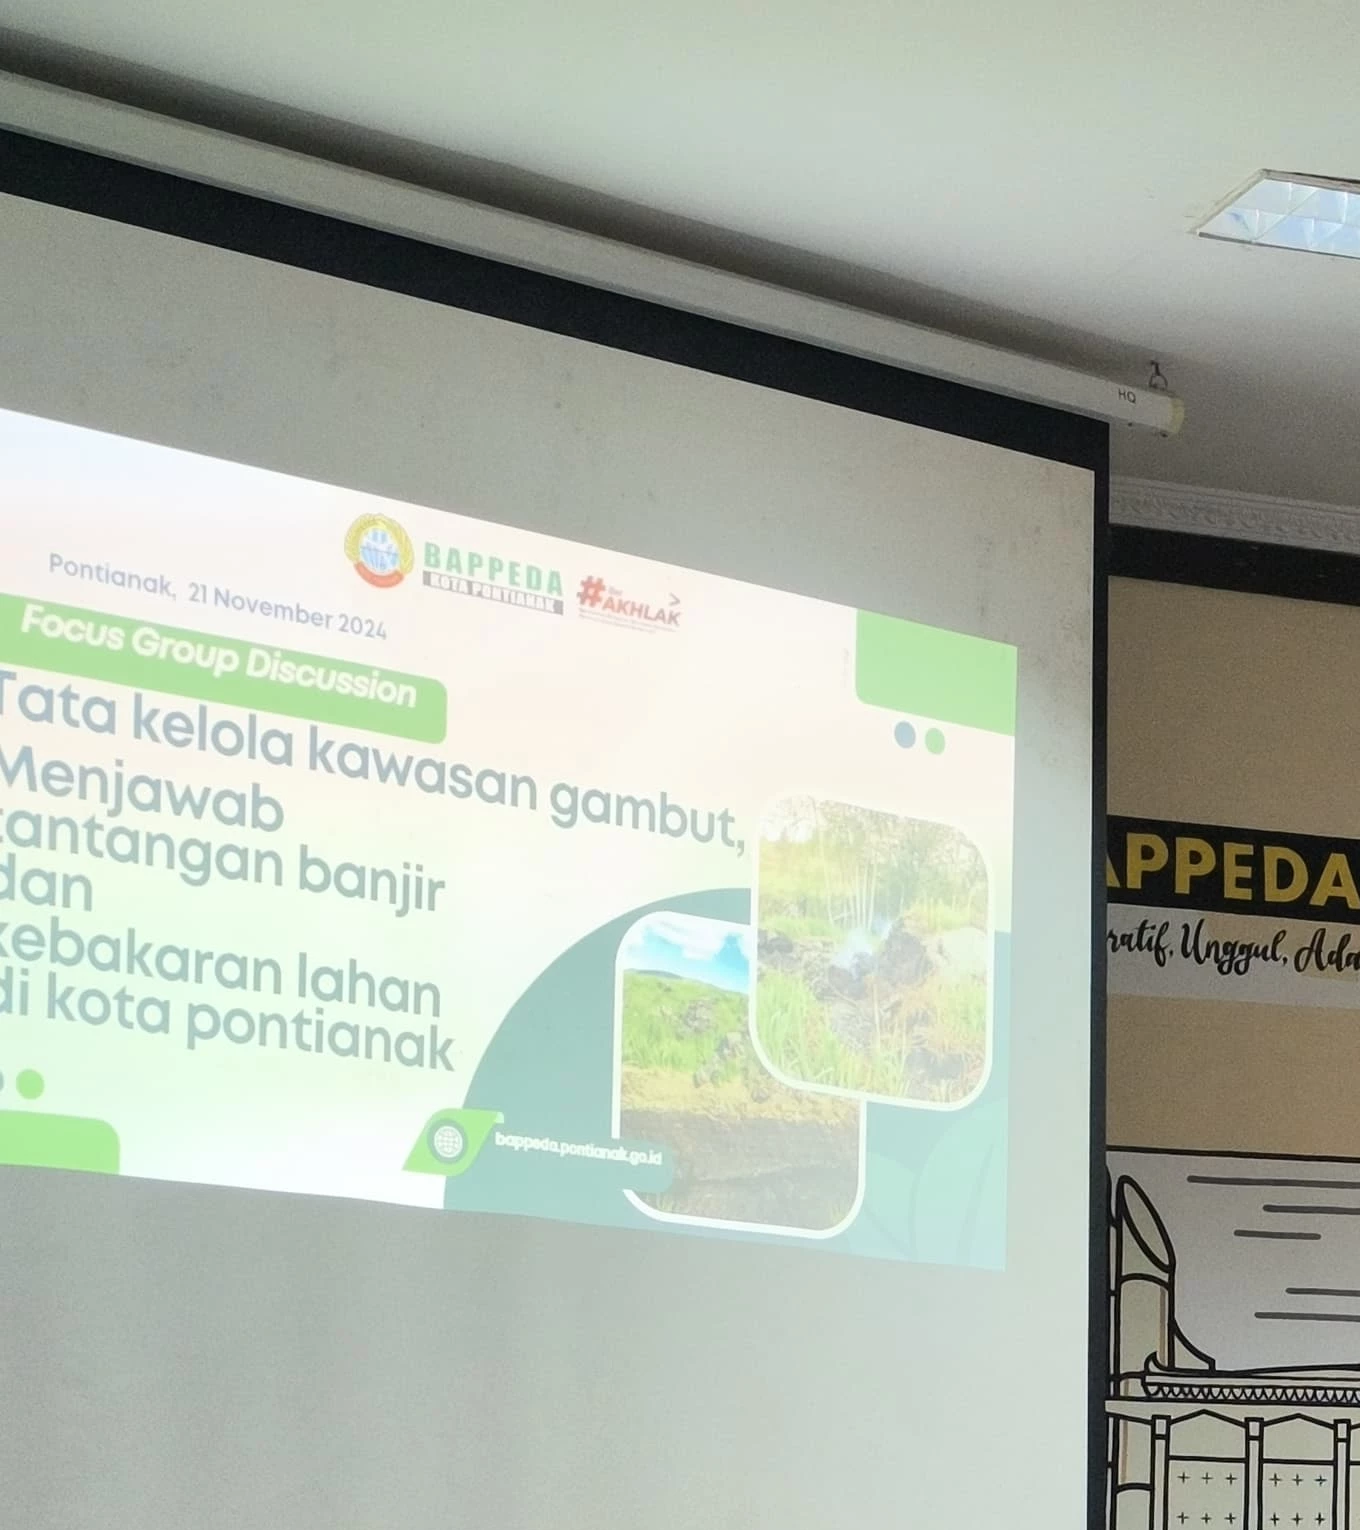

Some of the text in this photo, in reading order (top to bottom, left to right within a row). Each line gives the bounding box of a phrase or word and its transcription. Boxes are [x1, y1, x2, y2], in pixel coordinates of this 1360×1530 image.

[49, 552, 388, 640] Pontianak, 21 November 2024
[424, 542, 563, 596] BAPPEDA
[430, 572, 468, 595] KOTA
[21, 604, 417, 708] Focus Group Discussion
[0, 745, 284, 832] Menjawab
[133, 693, 293, 767] kelola
[309, 725, 537, 810] kawasan
[550, 781, 745, 857] gambut,
[300, 844, 445, 918] banjir
[48, 970, 171, 1034] kota
[187, 1002, 456, 1072] pontianak
[299, 952, 441, 1017] lahan
